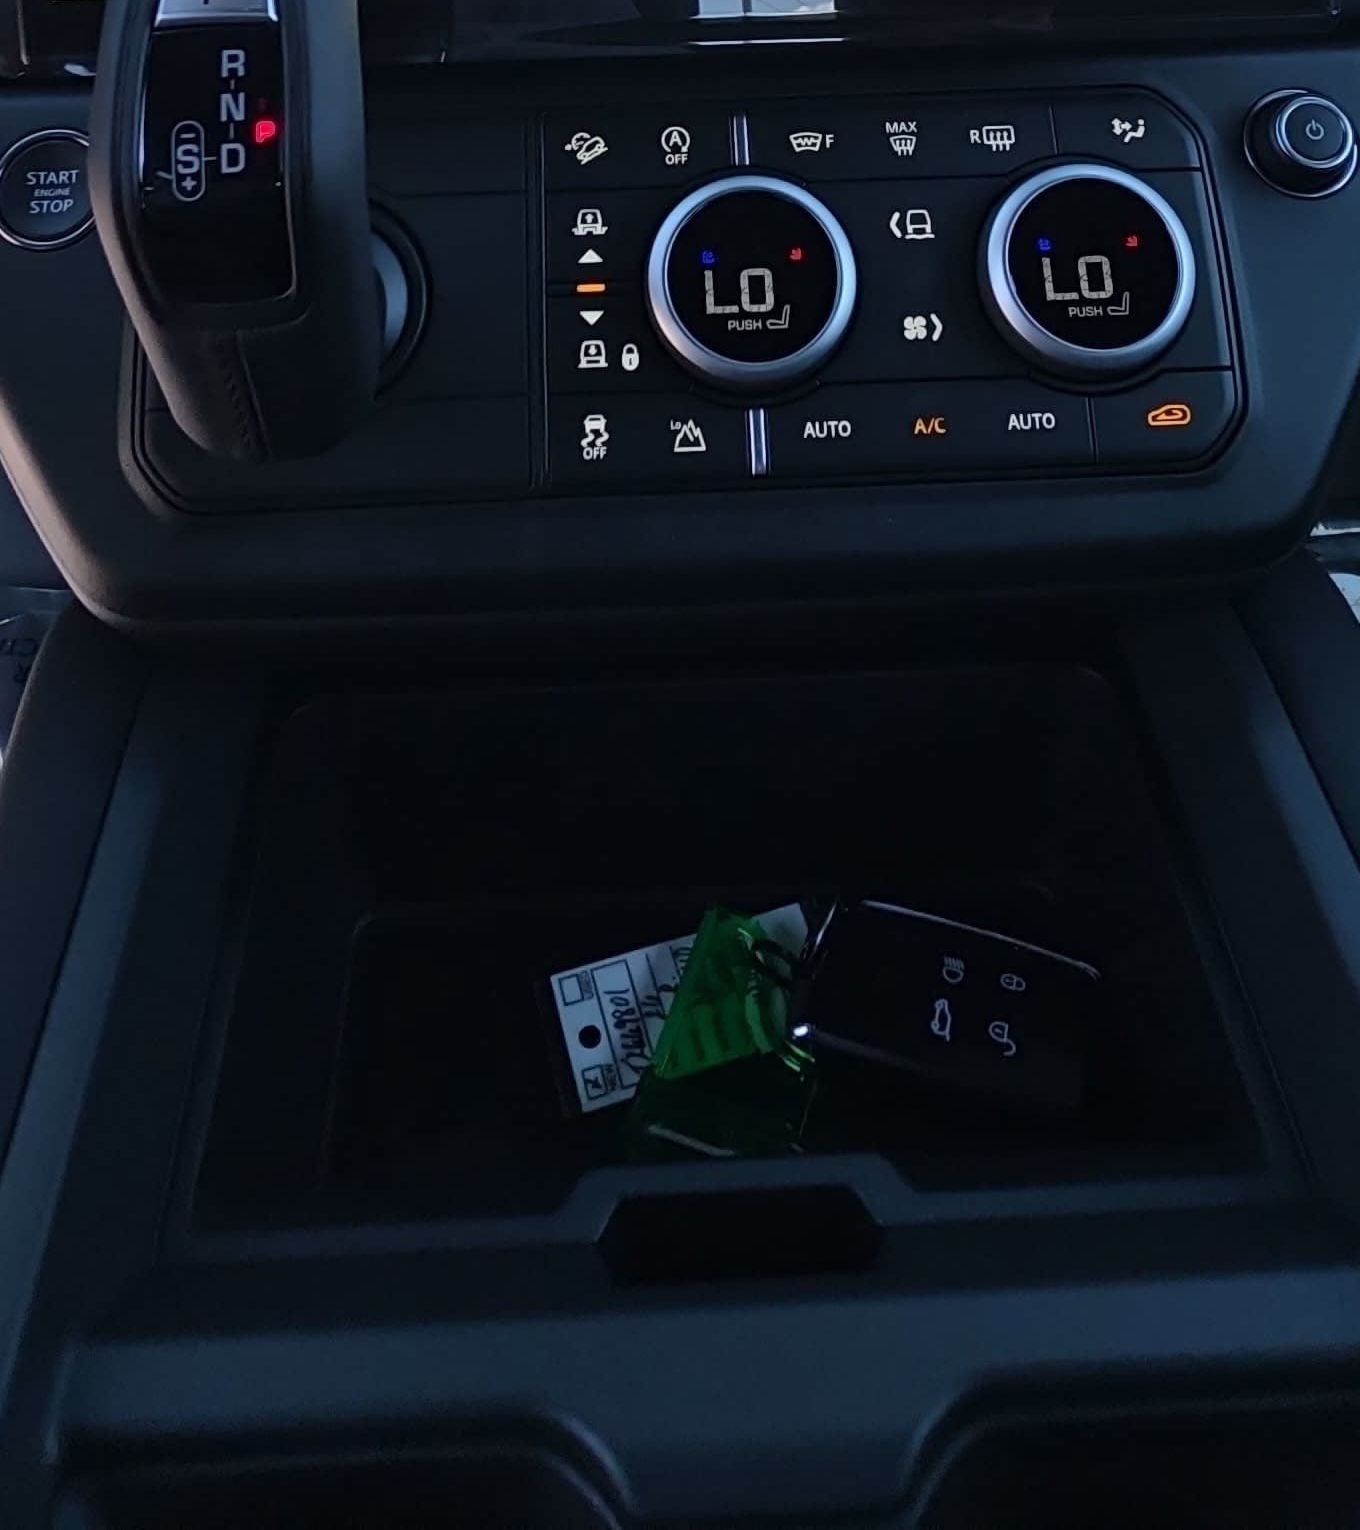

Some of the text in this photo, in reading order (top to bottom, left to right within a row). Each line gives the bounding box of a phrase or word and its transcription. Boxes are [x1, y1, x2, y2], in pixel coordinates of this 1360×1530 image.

[220, 49, 246, 78] R
[219, 93, 246, 121] N
[885, 121, 918, 135] MAX
[825, 134, 835, 150] F
[969, 129, 981, 145] R
[175, 143, 246, 176] S D
[665, 153, 688, 165] OFF
[25, 170, 79, 185] START
[34, 188, 71, 198] ENGINE
[29, 198, 74, 215] STOP
[1042, 255, 1115, 300] LO
[704, 267, 776, 315] LO
[1068, 305, 1103, 317] PUSH
[727, 318, 762, 331] PUSH
[803, 420, 852, 440] AUTO
[912, 415, 946, 436] A/C
[1007, 412, 1056, 432] AUTO
[582, 445, 608, 461] OFF
